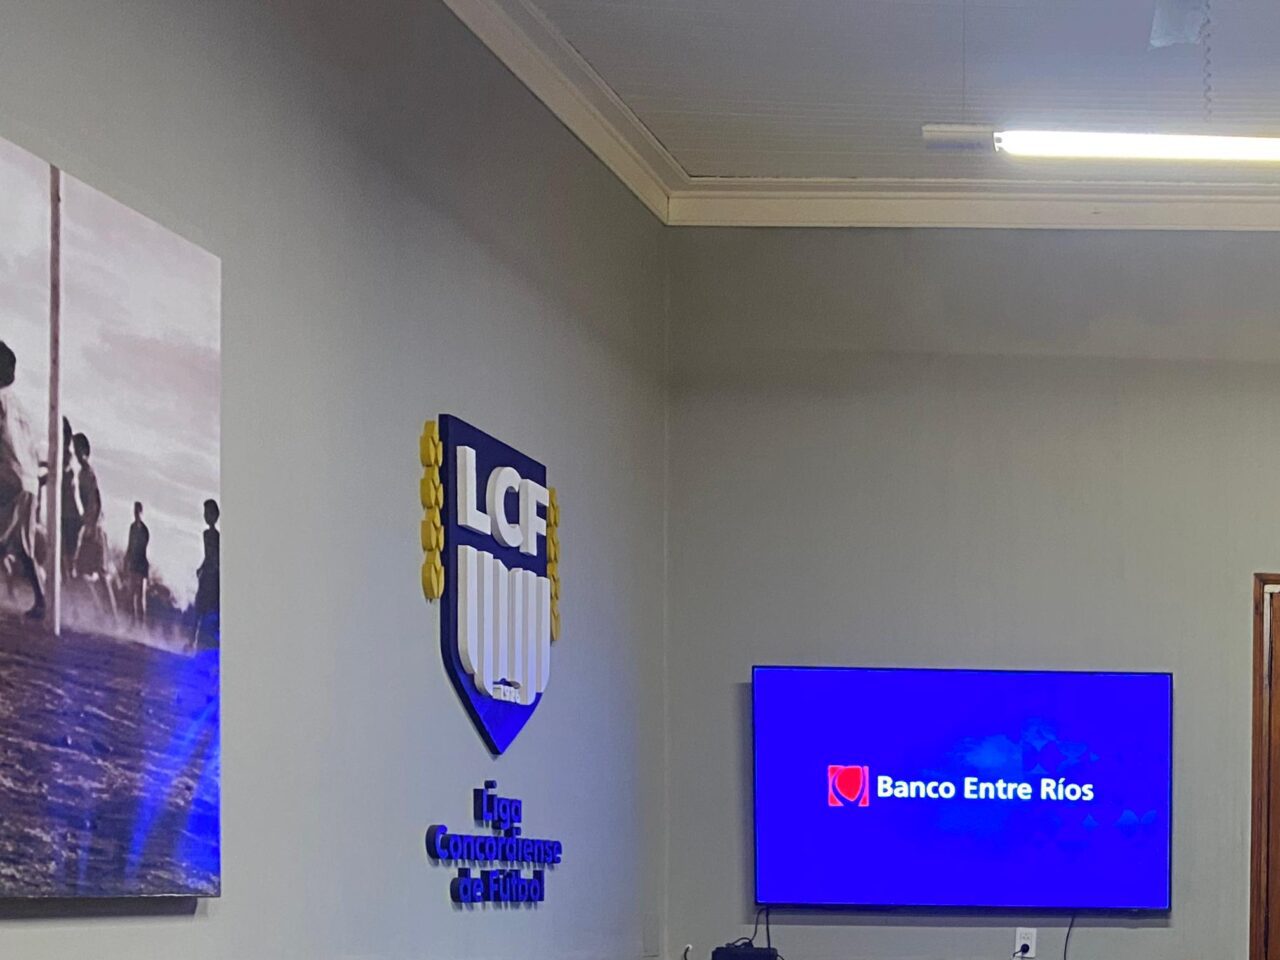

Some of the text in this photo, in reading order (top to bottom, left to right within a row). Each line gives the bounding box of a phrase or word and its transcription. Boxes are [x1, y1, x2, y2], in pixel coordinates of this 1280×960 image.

[456, 445, 550, 556] LCF
[473, 780, 522, 830] Liga
[877, 775, 1094, 801] Banco Entre Ríos
[426, 825, 563, 864] Concordiense
[450, 867, 545, 903] de Fútbol
